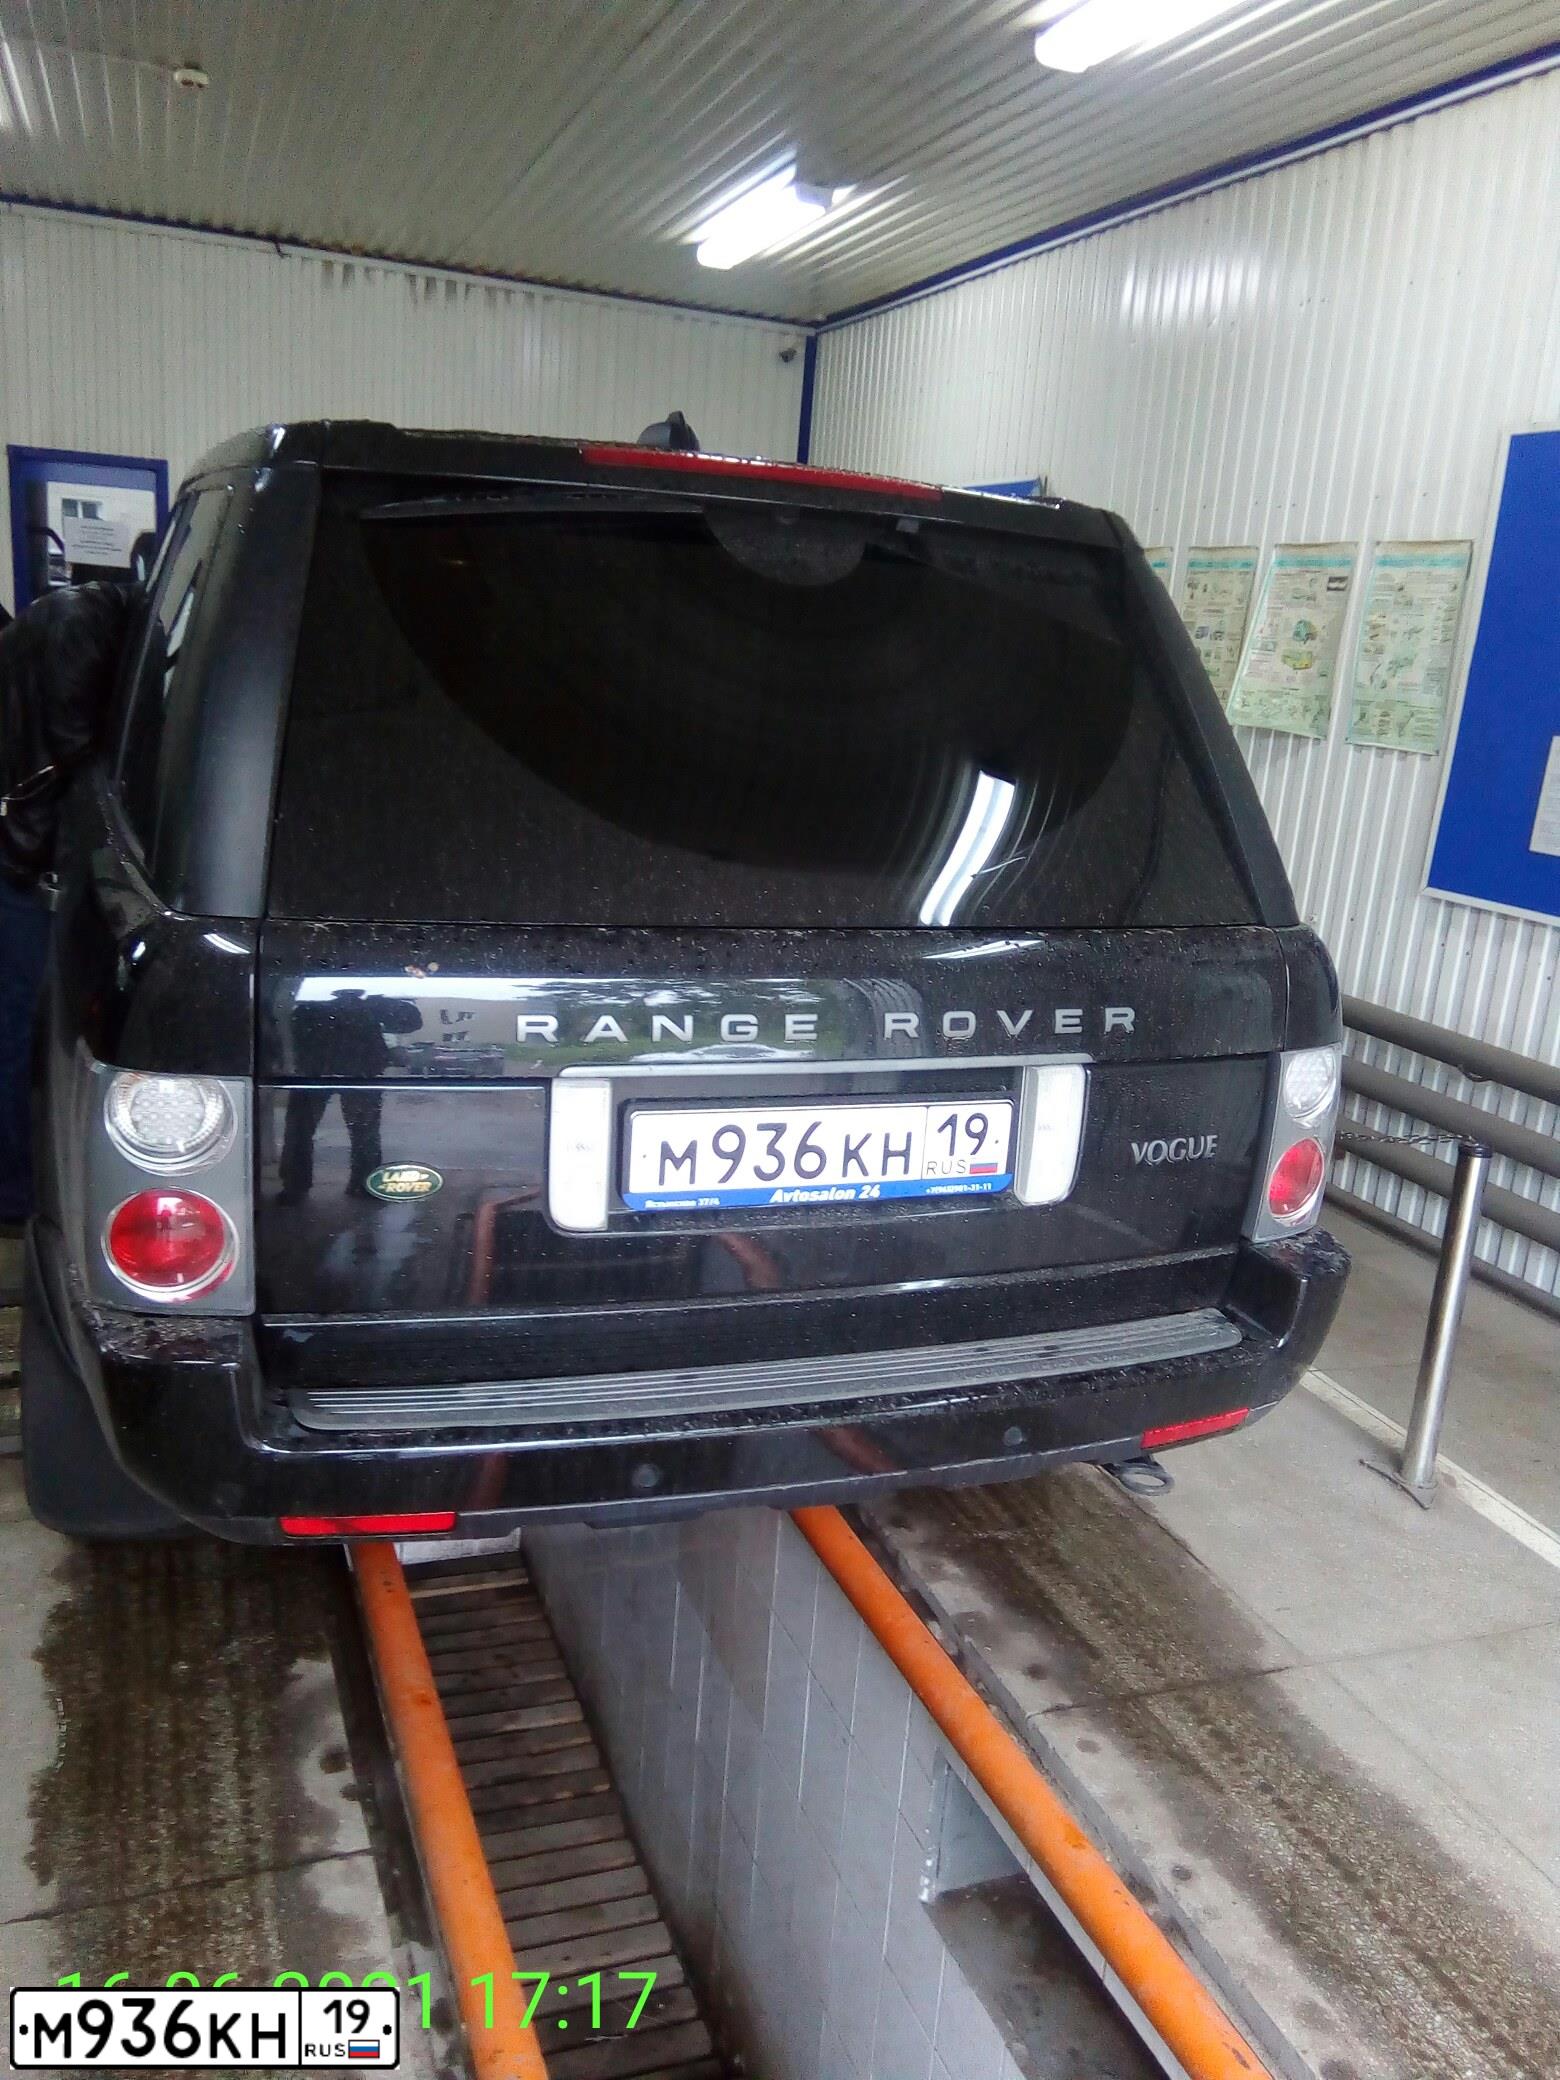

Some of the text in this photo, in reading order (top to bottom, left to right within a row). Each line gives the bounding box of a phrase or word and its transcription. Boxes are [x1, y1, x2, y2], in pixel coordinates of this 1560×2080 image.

[516, 1006, 1136, 1042] RANGE ROVER
[937, 1112, 988, 1156] 19
[1131, 1134, 1218, 1166] VOGUE
[926, 1160, 967, 1175] RUS
[384, 1182, 433, 1193] ROVER
[769, 1185, 881, 1203] Avtosalon 24
